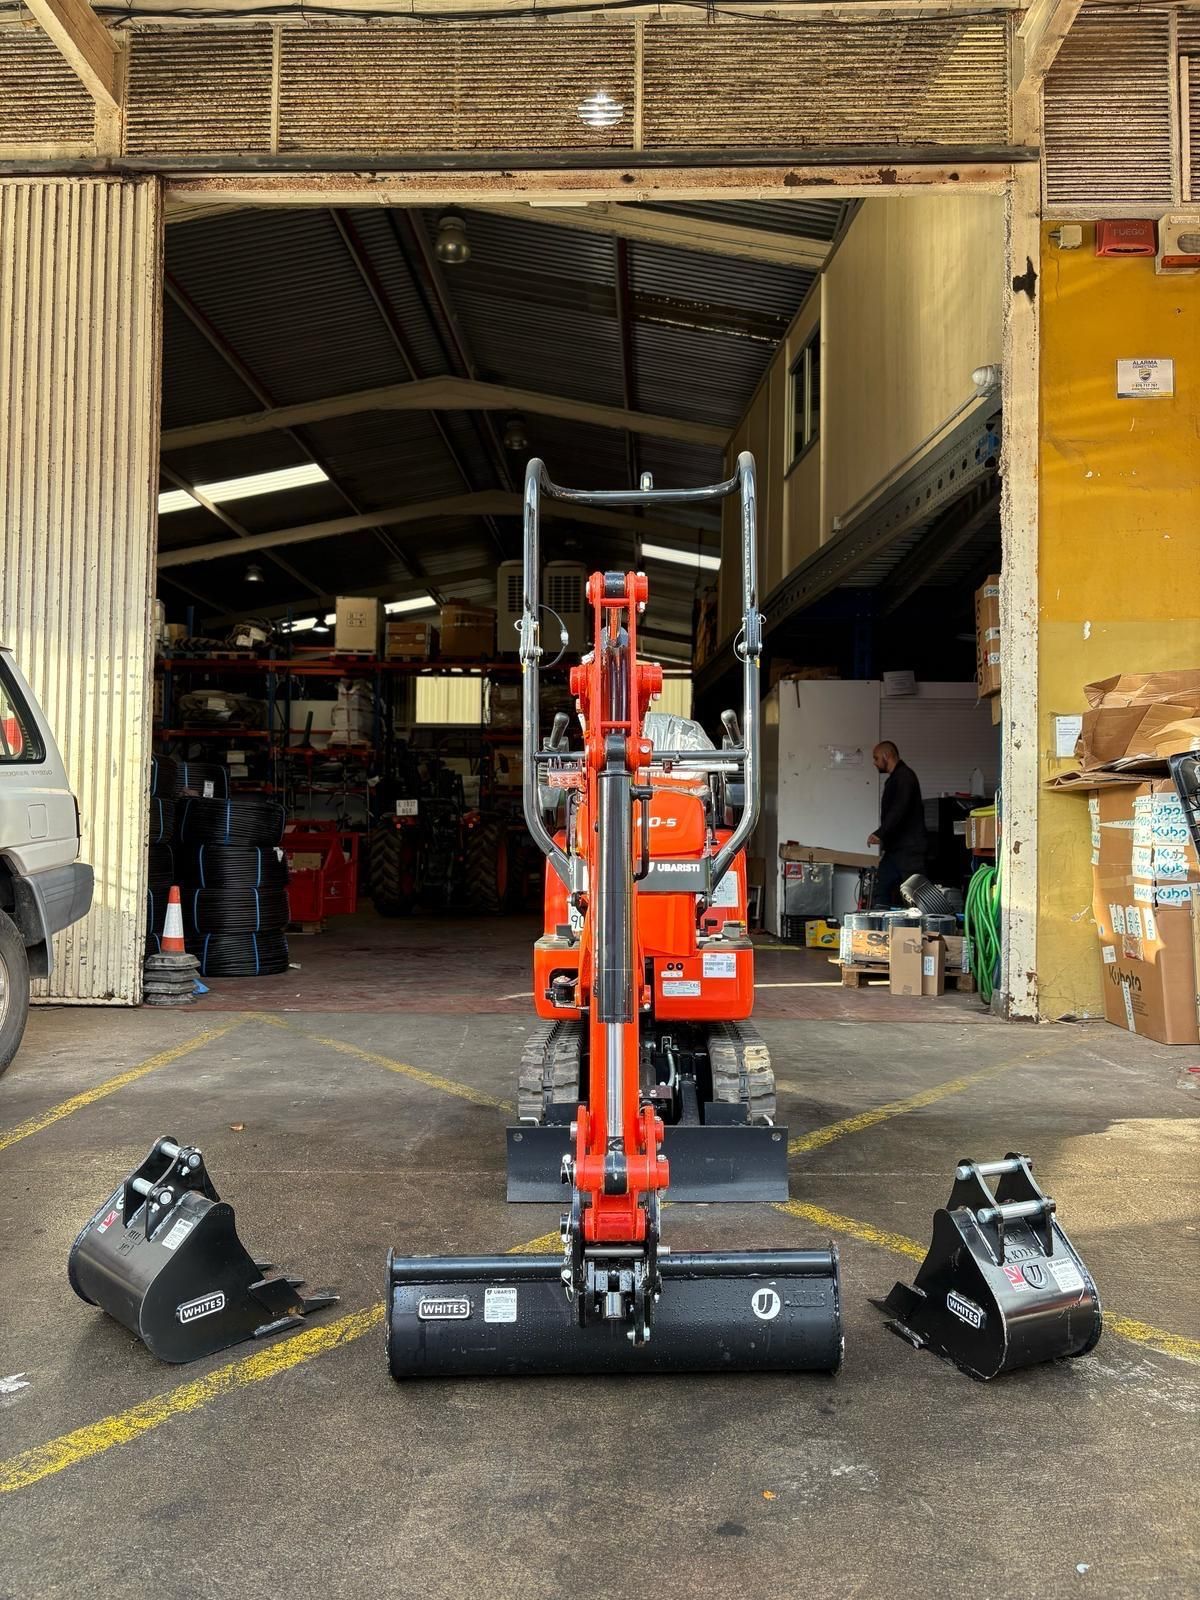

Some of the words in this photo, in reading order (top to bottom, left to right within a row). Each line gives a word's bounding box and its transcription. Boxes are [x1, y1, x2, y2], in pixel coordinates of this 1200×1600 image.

[1113, 228, 1146, 236] FUEGO
[657, 863, 700, 873] UBARISTI
[1109, 965, 1142, 991] Kubota
[184, 1298, 222, 1318] WHITES
[423, 1304, 466, 1314] WHITES
[949, 1298, 978, 1324] WHITES
